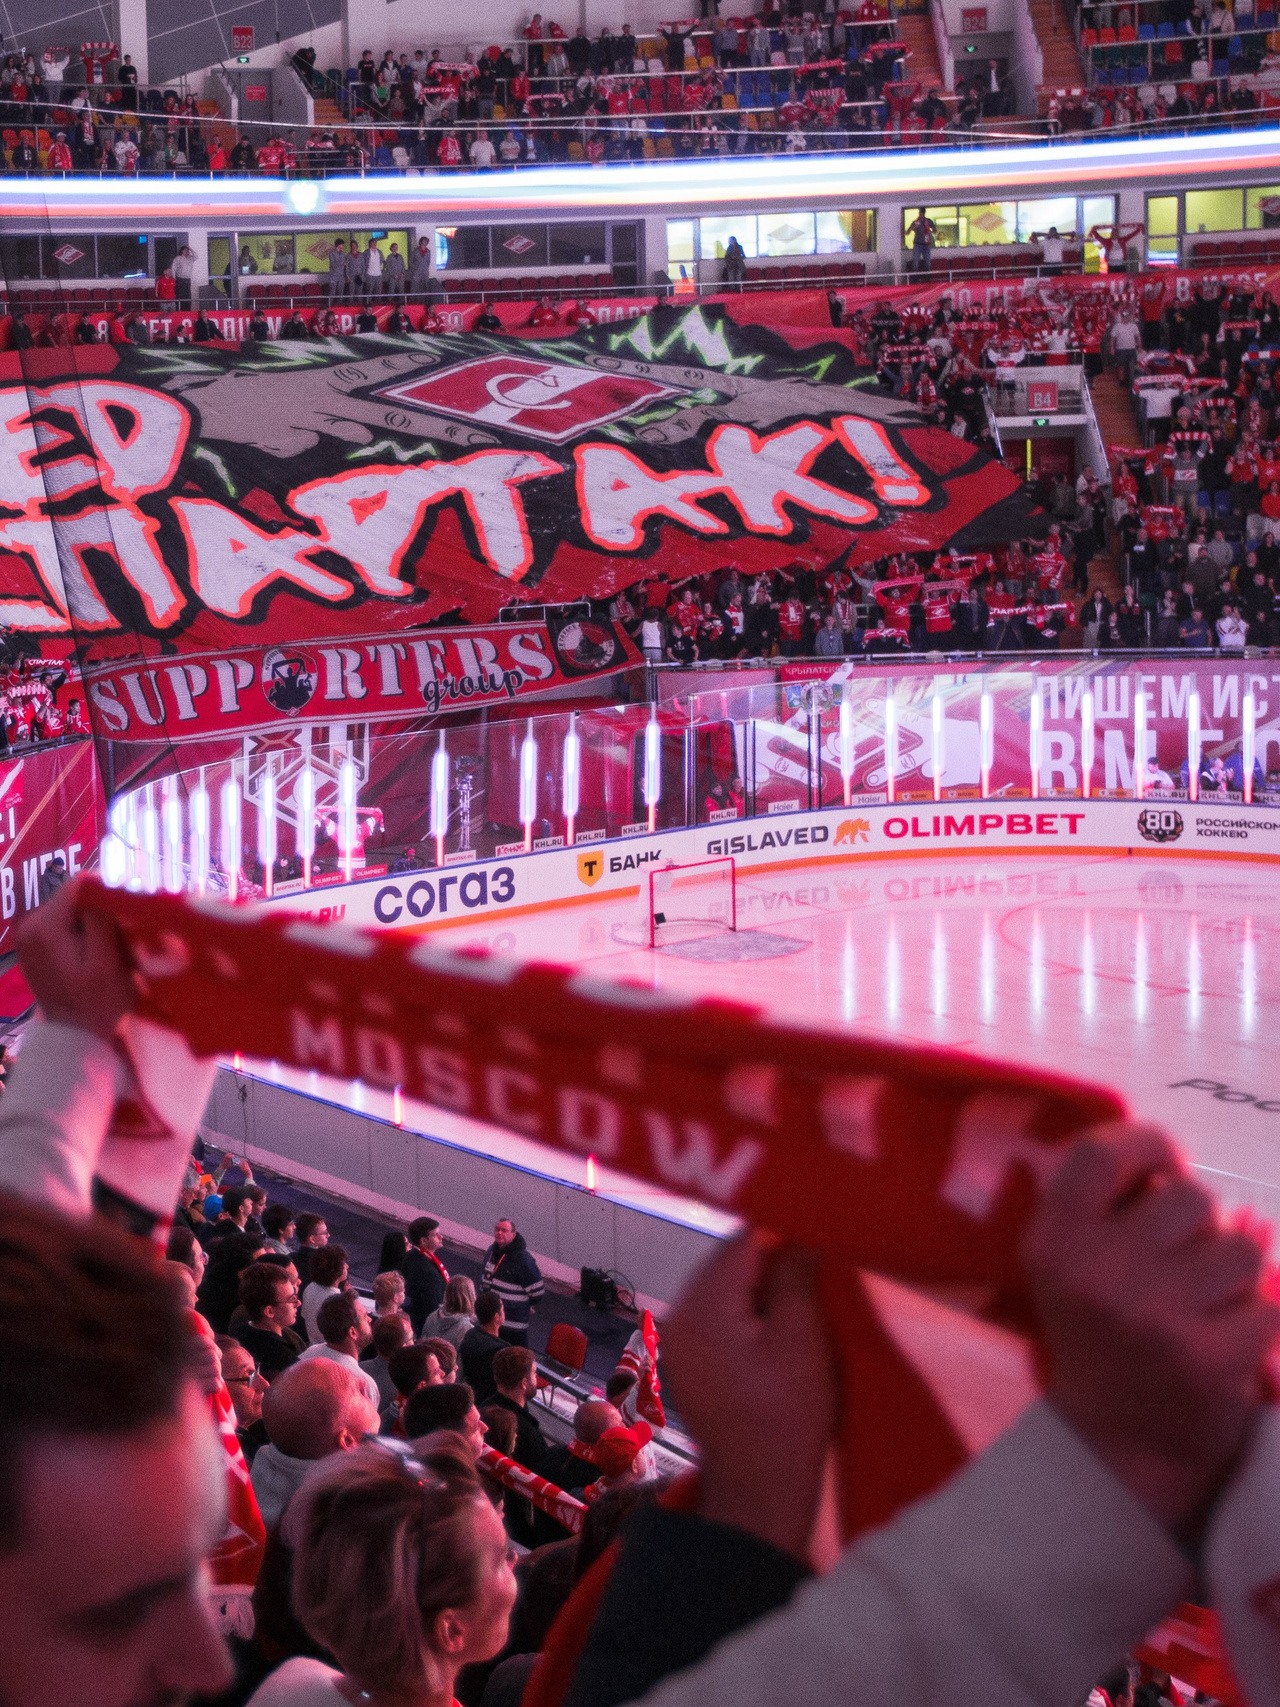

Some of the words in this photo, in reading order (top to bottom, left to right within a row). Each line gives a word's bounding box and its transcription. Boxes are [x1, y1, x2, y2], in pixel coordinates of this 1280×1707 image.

[1212, 675, 1280, 719] ИС
[858, 793, 881, 803] Haier
[773, 801, 794, 811] Haier
[711, 810, 736, 821] KHL.RU
[1145, 811, 1176, 830] 80
[623, 824, 649, 835] KHL.RU
[882, 813, 1086, 839] OLIMPBET
[1196, 828, 1248, 839] ХОККЕЮ
[535, 838, 562, 849] KHL.RU
[577, 831, 605, 842] KHL.RU
[706, 825, 830, 855] GISLAVED
[609, 849, 662, 873] БАНК
[1, 866, 17, 920] В
[291, 1005, 765, 1199] MOSCOW
